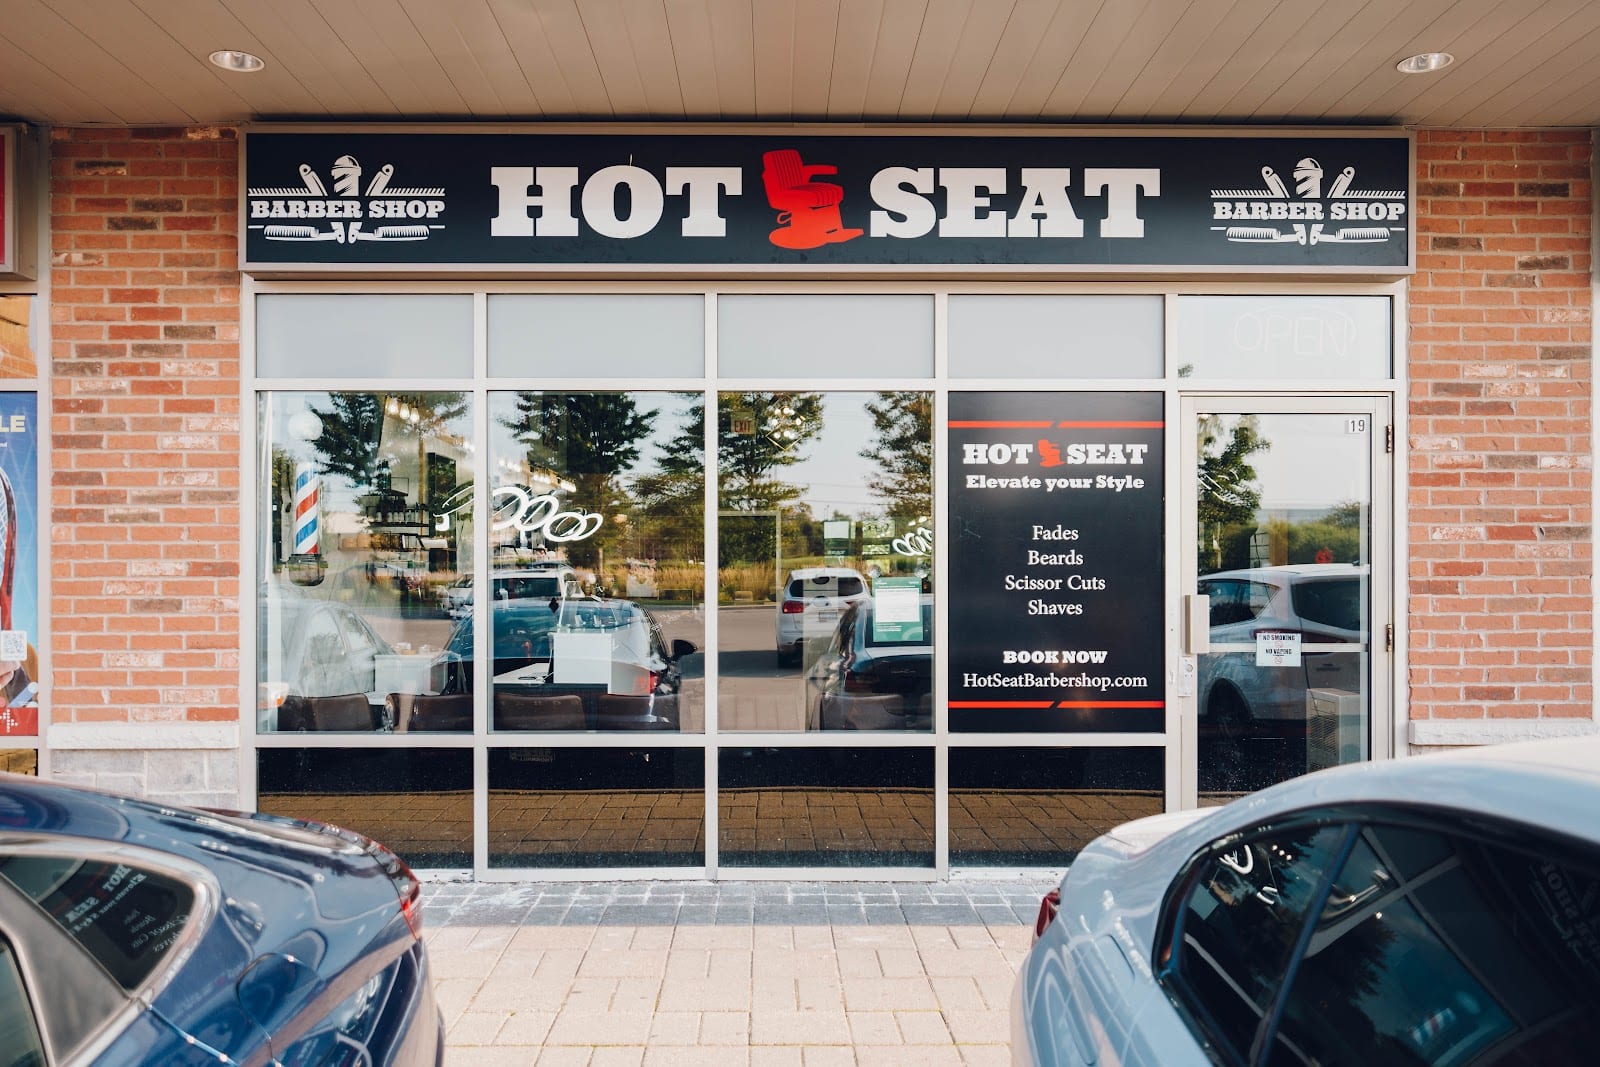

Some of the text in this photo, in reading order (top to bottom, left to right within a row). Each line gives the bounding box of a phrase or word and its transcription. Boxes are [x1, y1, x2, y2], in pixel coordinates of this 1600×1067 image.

[250, 200, 445, 219] BARBER SHOP
[491, 164, 1160, 239] HOT SEAT
[1212, 202, 1406, 221] BARBER SHOP
[1234, 312, 1348, 357] OPEN
[1350, 419, 1365, 433] 19
[963, 443, 1148, 465] HOT SEAT
[966, 474, 1145, 492] Elevate your Style
[1032, 524, 1079, 540] Fades
[1027, 549, 1084, 565] Beards
[1005, 574, 1106, 590] Scissor Cuts
[1028, 599, 1083, 615] Shaves
[1003, 650, 1108, 664] BOOK NOW
[963, 672, 1148, 692] HotSeatBarbershop.com
